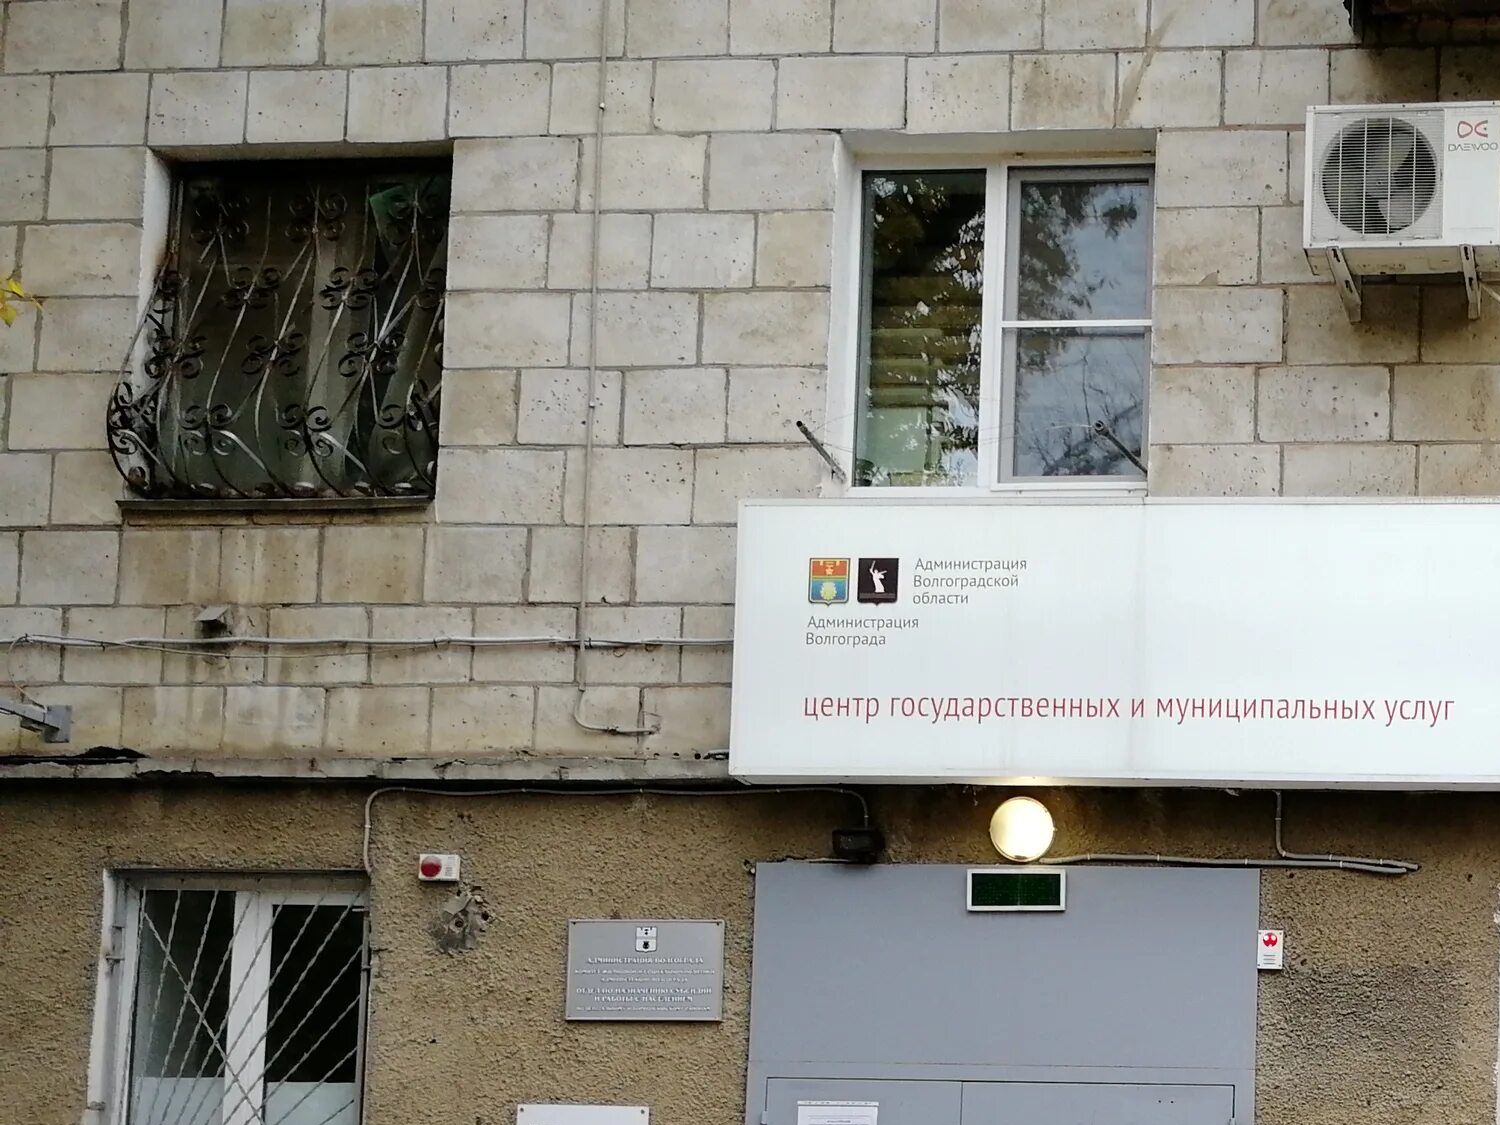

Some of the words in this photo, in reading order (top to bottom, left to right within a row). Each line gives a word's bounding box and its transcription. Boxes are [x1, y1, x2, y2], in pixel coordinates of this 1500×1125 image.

[1447, 142, 1499, 152] DAEWOO
[914, 557, 1027, 572] Администрация
[913, 574, 1019, 590] Волгоградской
[912, 591, 969, 605] области
[807, 615, 919, 631] Администрация
[805, 632, 886, 648] Волгограда
[804, 696, 880, 725] центр
[890, 696, 1120, 725] государственных
[1131, 698, 1145, 718] и
[1156, 697, 1375, 726] муниципальных
[1384, 699, 1455, 728] услуг
